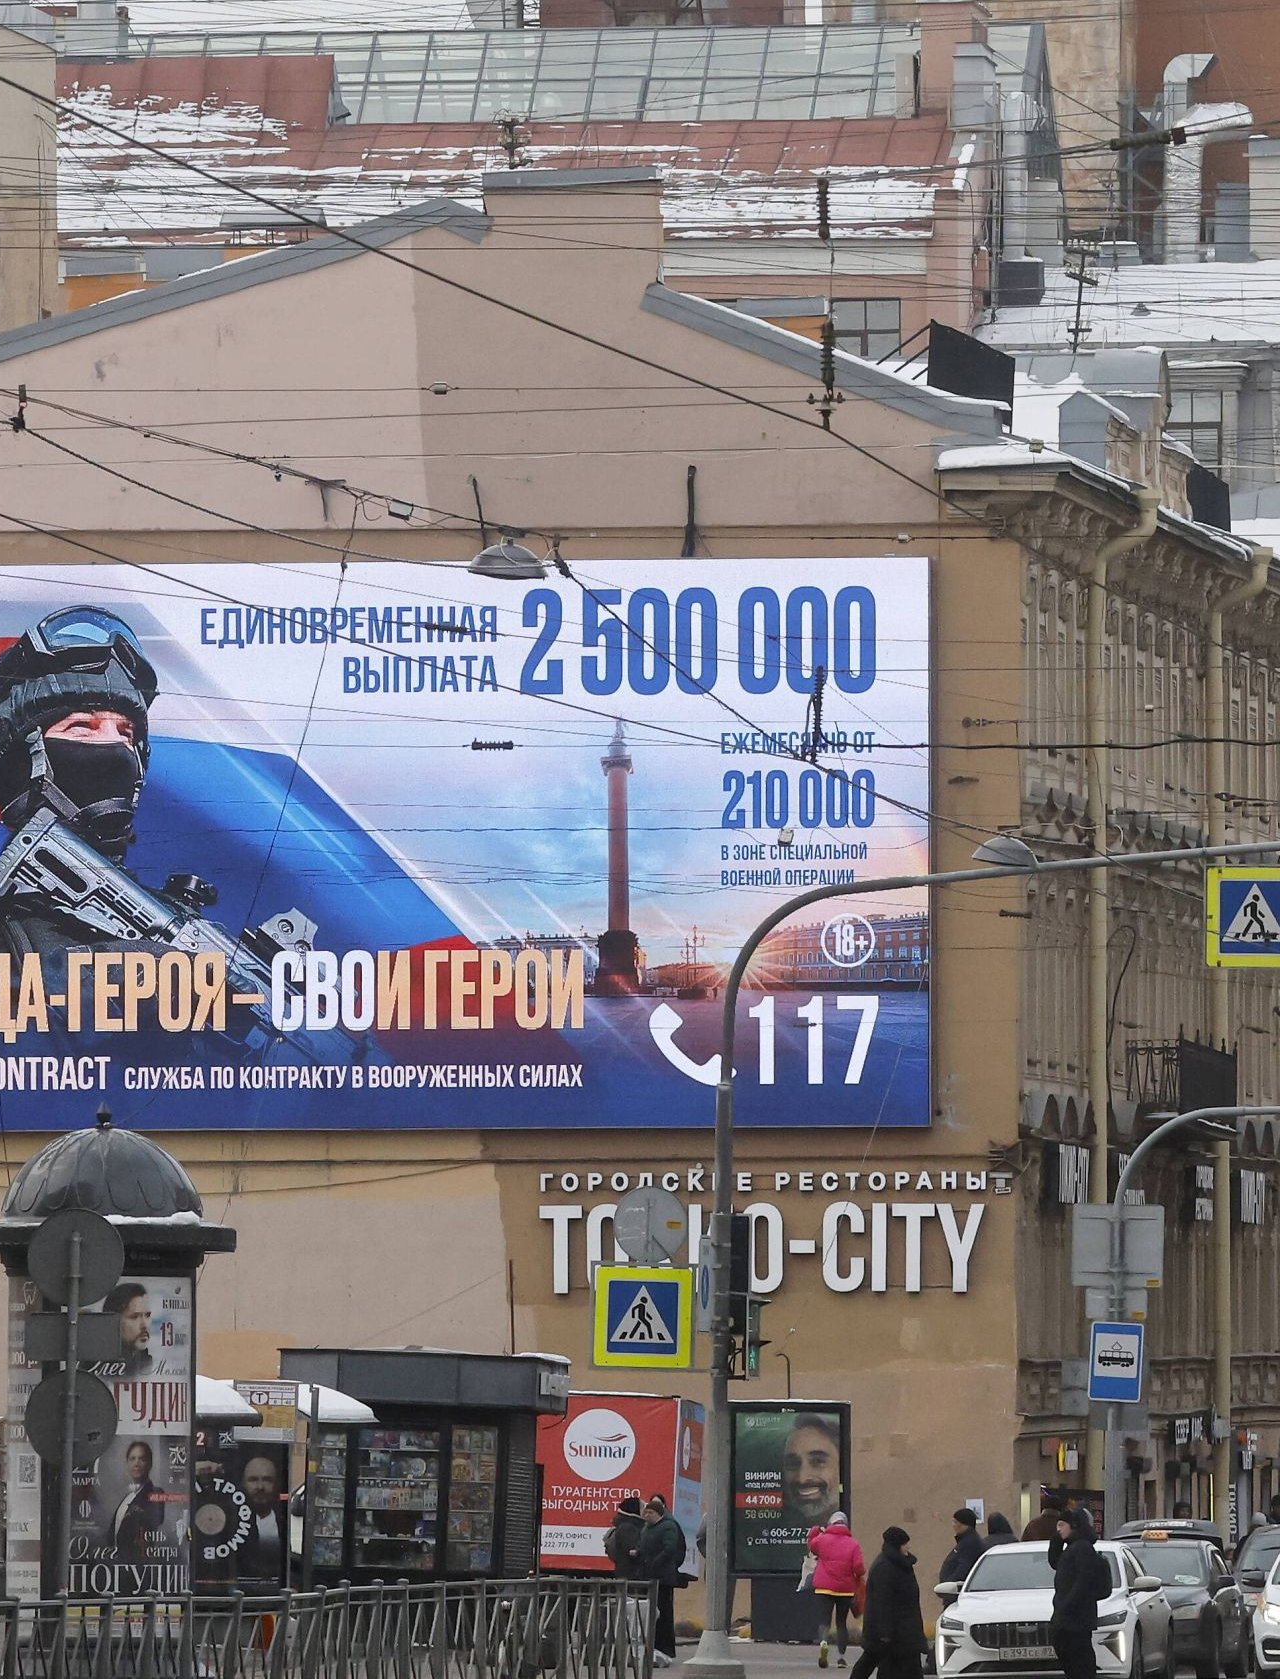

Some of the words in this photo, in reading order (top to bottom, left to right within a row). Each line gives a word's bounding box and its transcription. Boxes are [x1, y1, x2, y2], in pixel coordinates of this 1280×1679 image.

[201, 605, 497, 648] ЕДИНОВРЕМЕННАЯ
[520, 588, 563, 695] 2
[581, 587, 718, 695] 500
[738, 586, 876, 694] 000
[343, 655, 498, 693] ВЫПЛАТА
[720, 731, 848, 754] ЕЖЕМЕСЯНО
[853, 731, 875, 753] ОТ
[722, 770, 789, 829] 210
[799, 769, 875, 828] 000
[721, 845, 729, 860] В
[733, 845, 766, 860] ЗОНЕ
[770, 842, 867, 861] СПЕЦИАЛЬНОЙ
[721, 868, 781, 886] ВОЕННОЙ
[785, 869, 854, 886] ОПЕРАЦИИ
[833, 924, 869, 956] 18+
[271, 950, 410, 1032] СВОИ
[423, 949, 584, 1030] ГЕРОИ
[749, 995, 880, 1085] 117
[124, 1066, 205, 1090] СЛУЖБА
[210, 1067, 235, 1089] ПО
[239, 1066, 347, 1089] КОНТРАКТУ
[352, 1066, 363, 1088] В
[368, 1064, 512, 1088] ВООРУЖЕННЫХ
[519, 1064, 583, 1088] СИЛАХ
[539, 1171, 752, 1192] ГОРОДСКЕ
[775, 1170, 988, 1192] РЕСТОРАНЫ
[160, 1321, 174, 1347] 13
[568, 1441, 631, 1459] Sunmar
[72, 1477, 101, 1486] МАРТА
[745, 1471, 782, 1481] ВИНИРЫ
[552, 1485, 641, 1499] ТУРАГЕНТСТВО
[541, 1499, 609, 1513] ВЫГОДНЫХ
[204, 1478, 252, 1560] ТРОФИМОВ
[770, 1528, 811, 1537] 606-77-7
[68, 1535, 118, 1560] Олег
